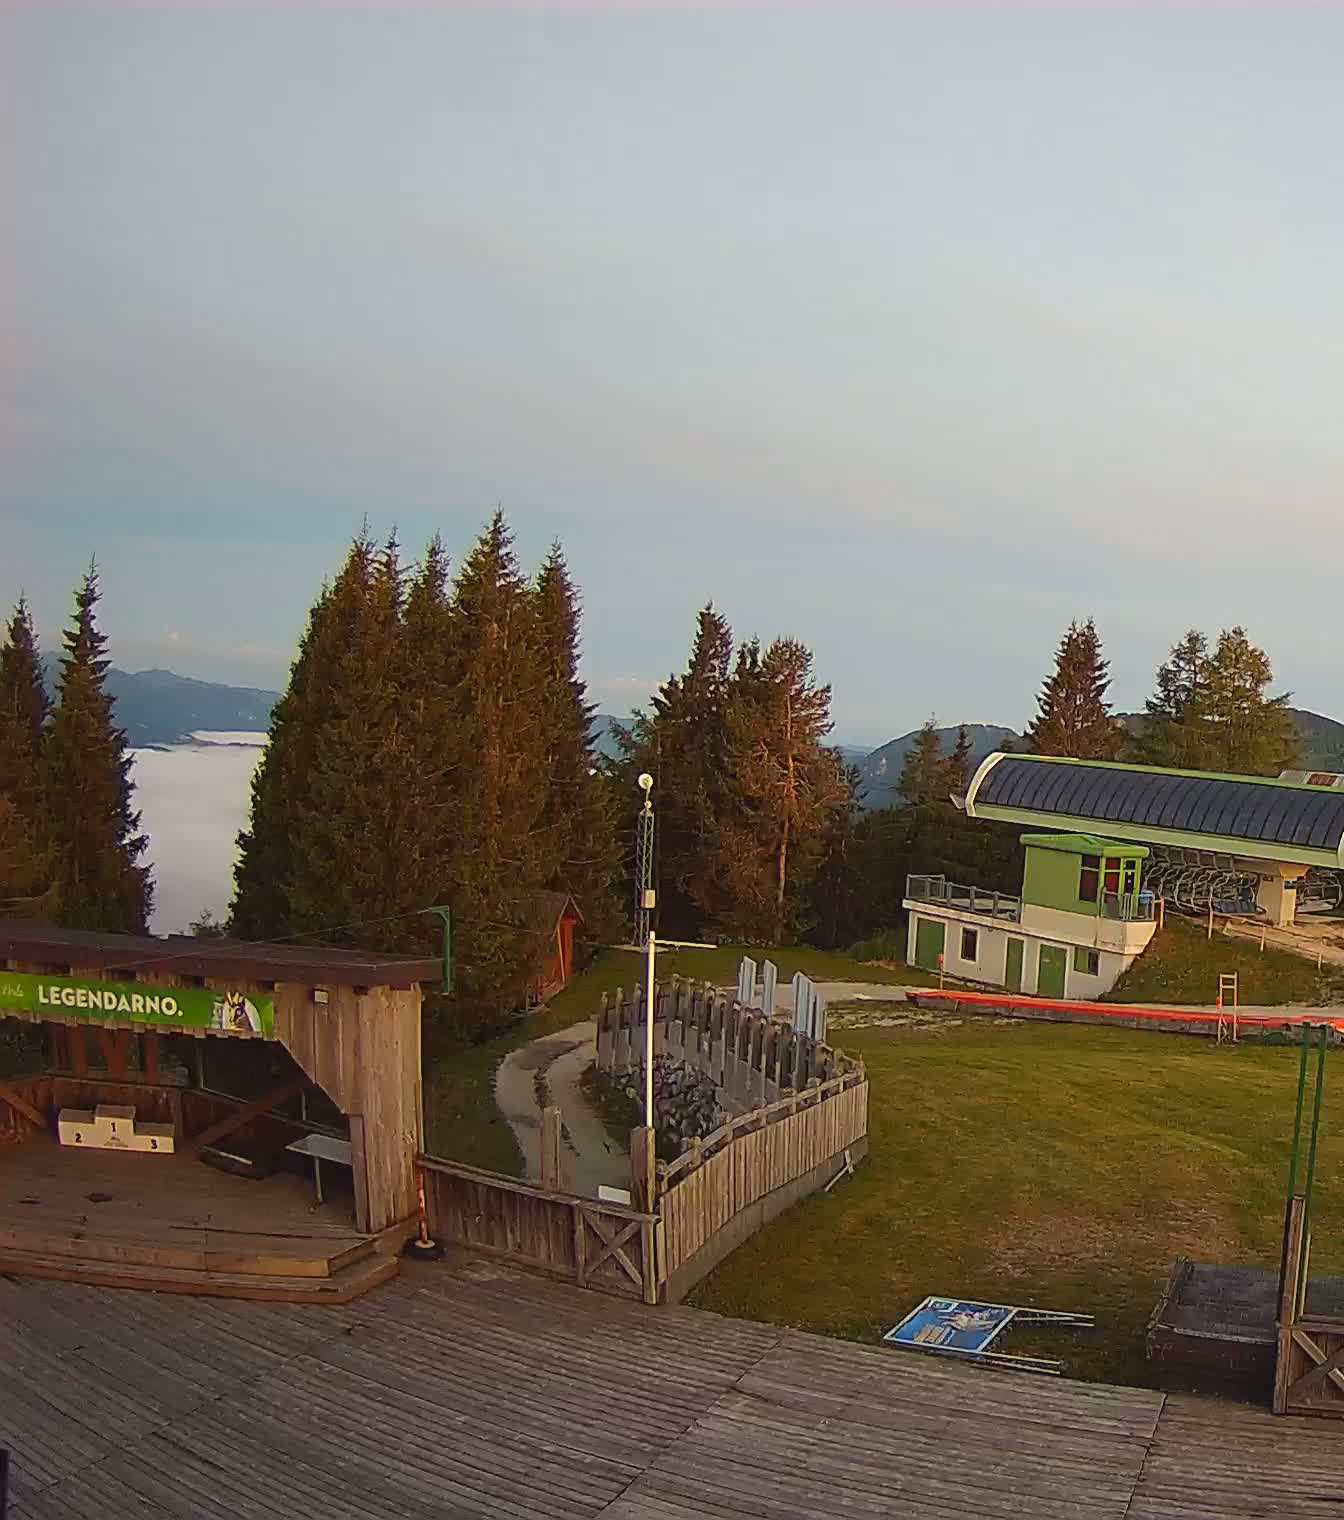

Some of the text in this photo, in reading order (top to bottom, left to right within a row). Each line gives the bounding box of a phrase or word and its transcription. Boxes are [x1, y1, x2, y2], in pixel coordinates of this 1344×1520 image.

[37, 984, 183, 1017] LEGENDARNO.
[110, 1122, 117, 1133] 1
[75, 1132, 83, 1144] 2
[150, 1138, 158, 1150] 3
